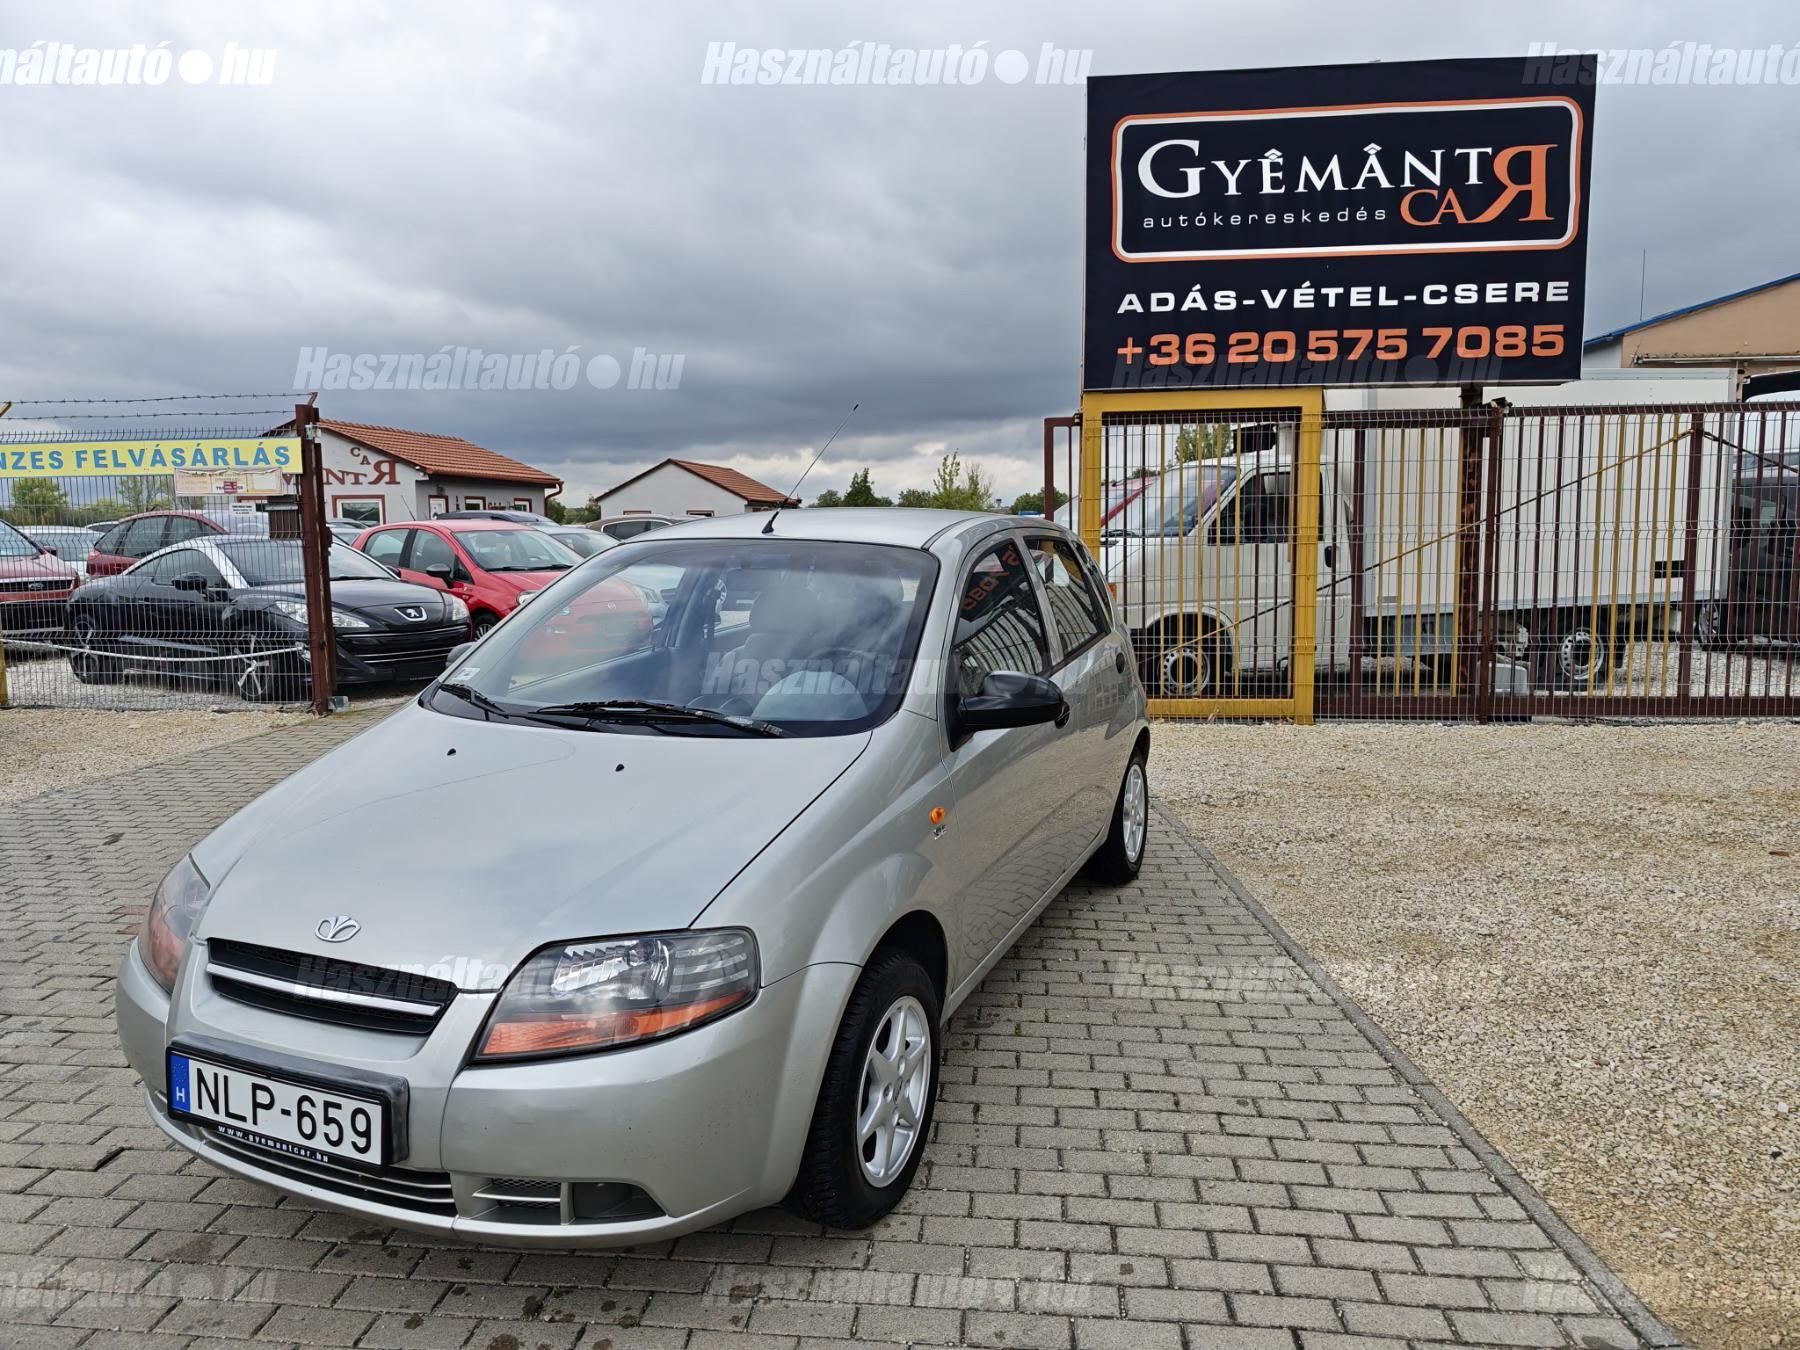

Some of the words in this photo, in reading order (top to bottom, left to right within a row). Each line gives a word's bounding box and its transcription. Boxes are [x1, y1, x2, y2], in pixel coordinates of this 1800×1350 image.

[1143, 206, 1386, 229] autókereskedés
[1116, 280, 1569, 314] ADÁS-VÉTEL-CSERE
[1117, 333, 1216, 366] +36
[1227, 331, 1296, 364] 20
[1307, 328, 1408, 362] 575
[1422, 325, 1565, 359] 7085
[75, 443, 291, 470] FELVÁSÁRLÁS
[175, 1086, 186, 1103] H
[196, 1067, 372, 1154] NLP-659
